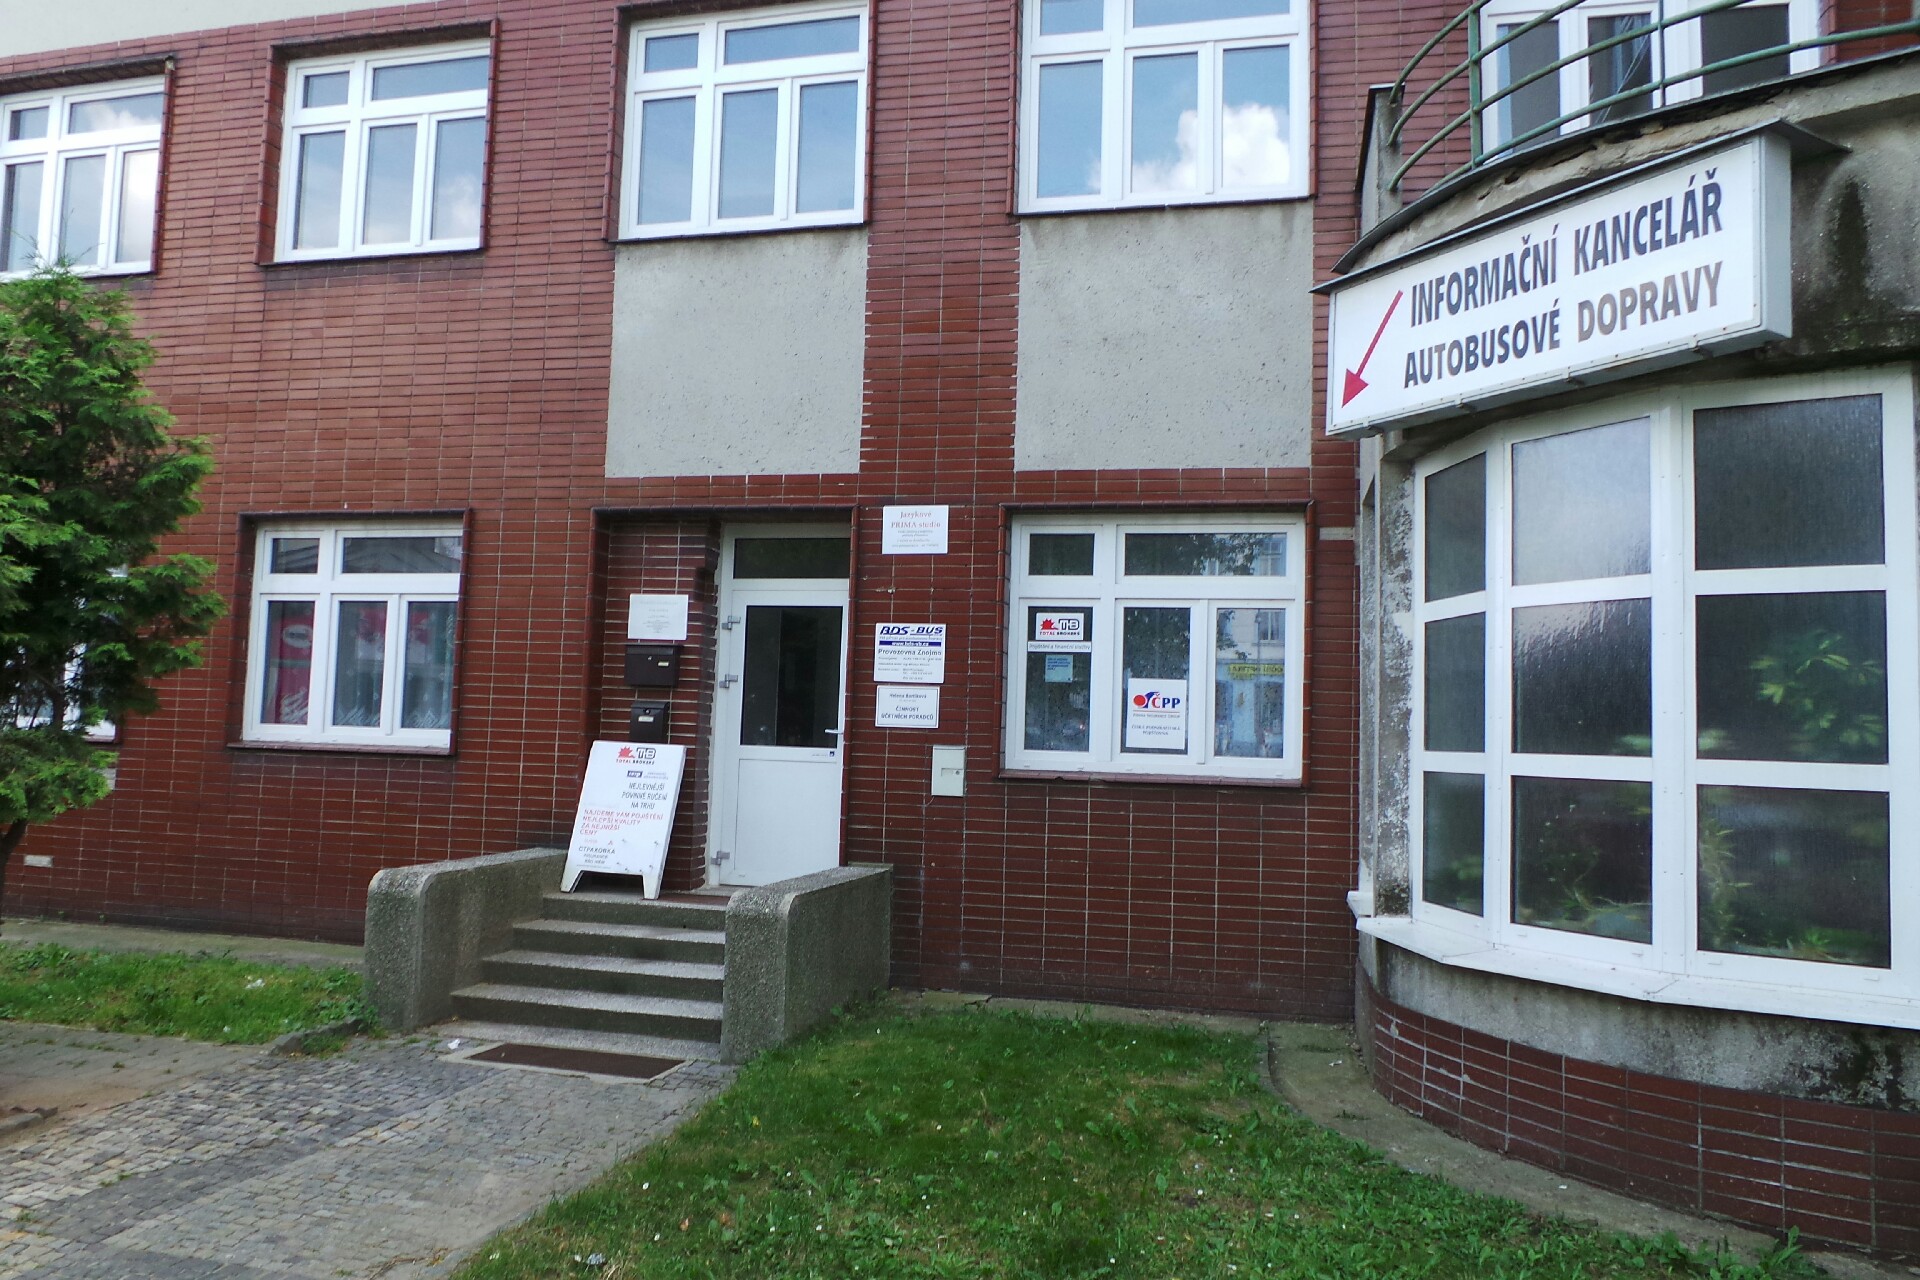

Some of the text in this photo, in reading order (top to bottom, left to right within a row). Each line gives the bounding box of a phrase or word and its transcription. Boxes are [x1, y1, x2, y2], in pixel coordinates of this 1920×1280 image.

[1411, 166, 1723, 328] INFORMAČNÍ KANCELÁŘ
[1403, 260, 1724, 389] AUTOBUSOVÉ DOPRAVY
[878, 648, 942, 657] Provozovna Znojmo
[1151, 693, 1181, 709] ČPP
[640, 802, 655, 810] TRHU
